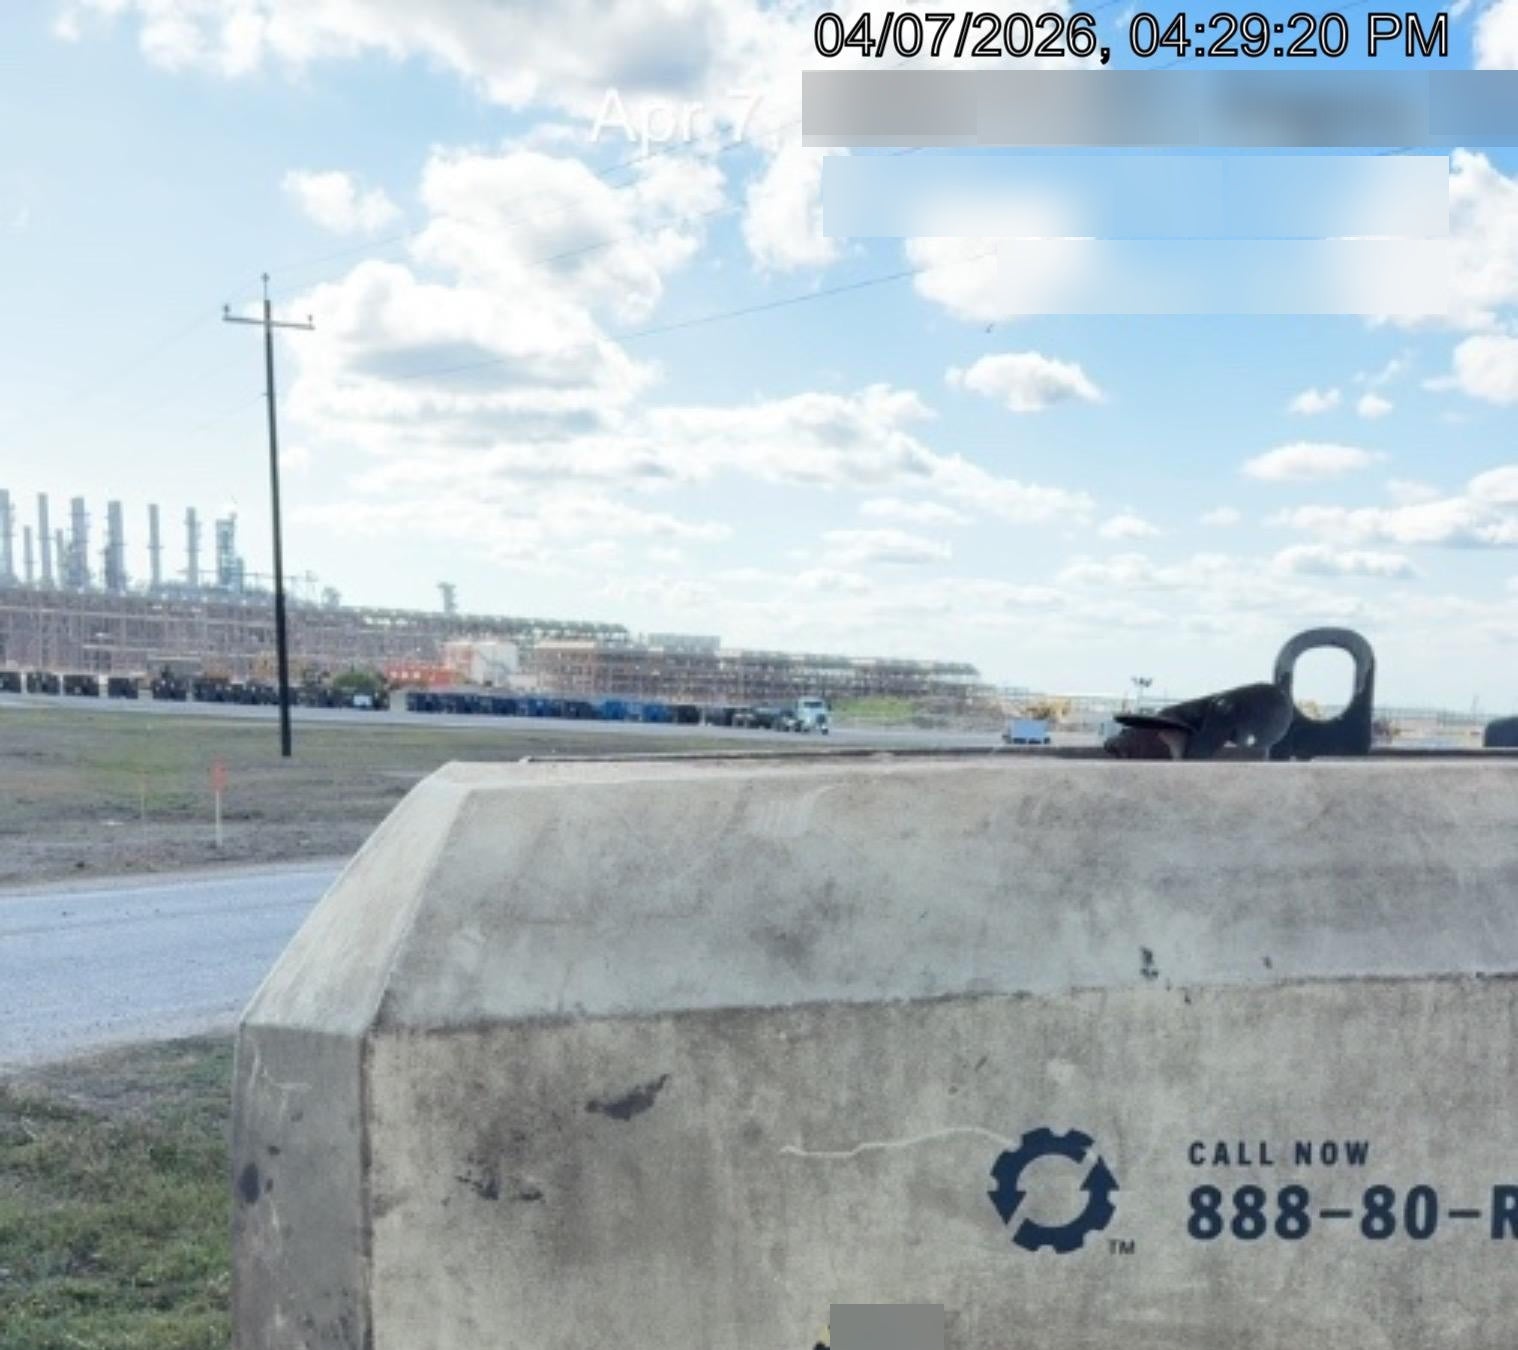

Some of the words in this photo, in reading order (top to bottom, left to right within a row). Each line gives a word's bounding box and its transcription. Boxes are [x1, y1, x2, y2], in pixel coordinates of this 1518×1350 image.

[1189, 1141, 1275, 1166] CALL
[1295, 1141, 1369, 1166] NOW
[1187, 1185, 1518, 1240] 888-80-R
